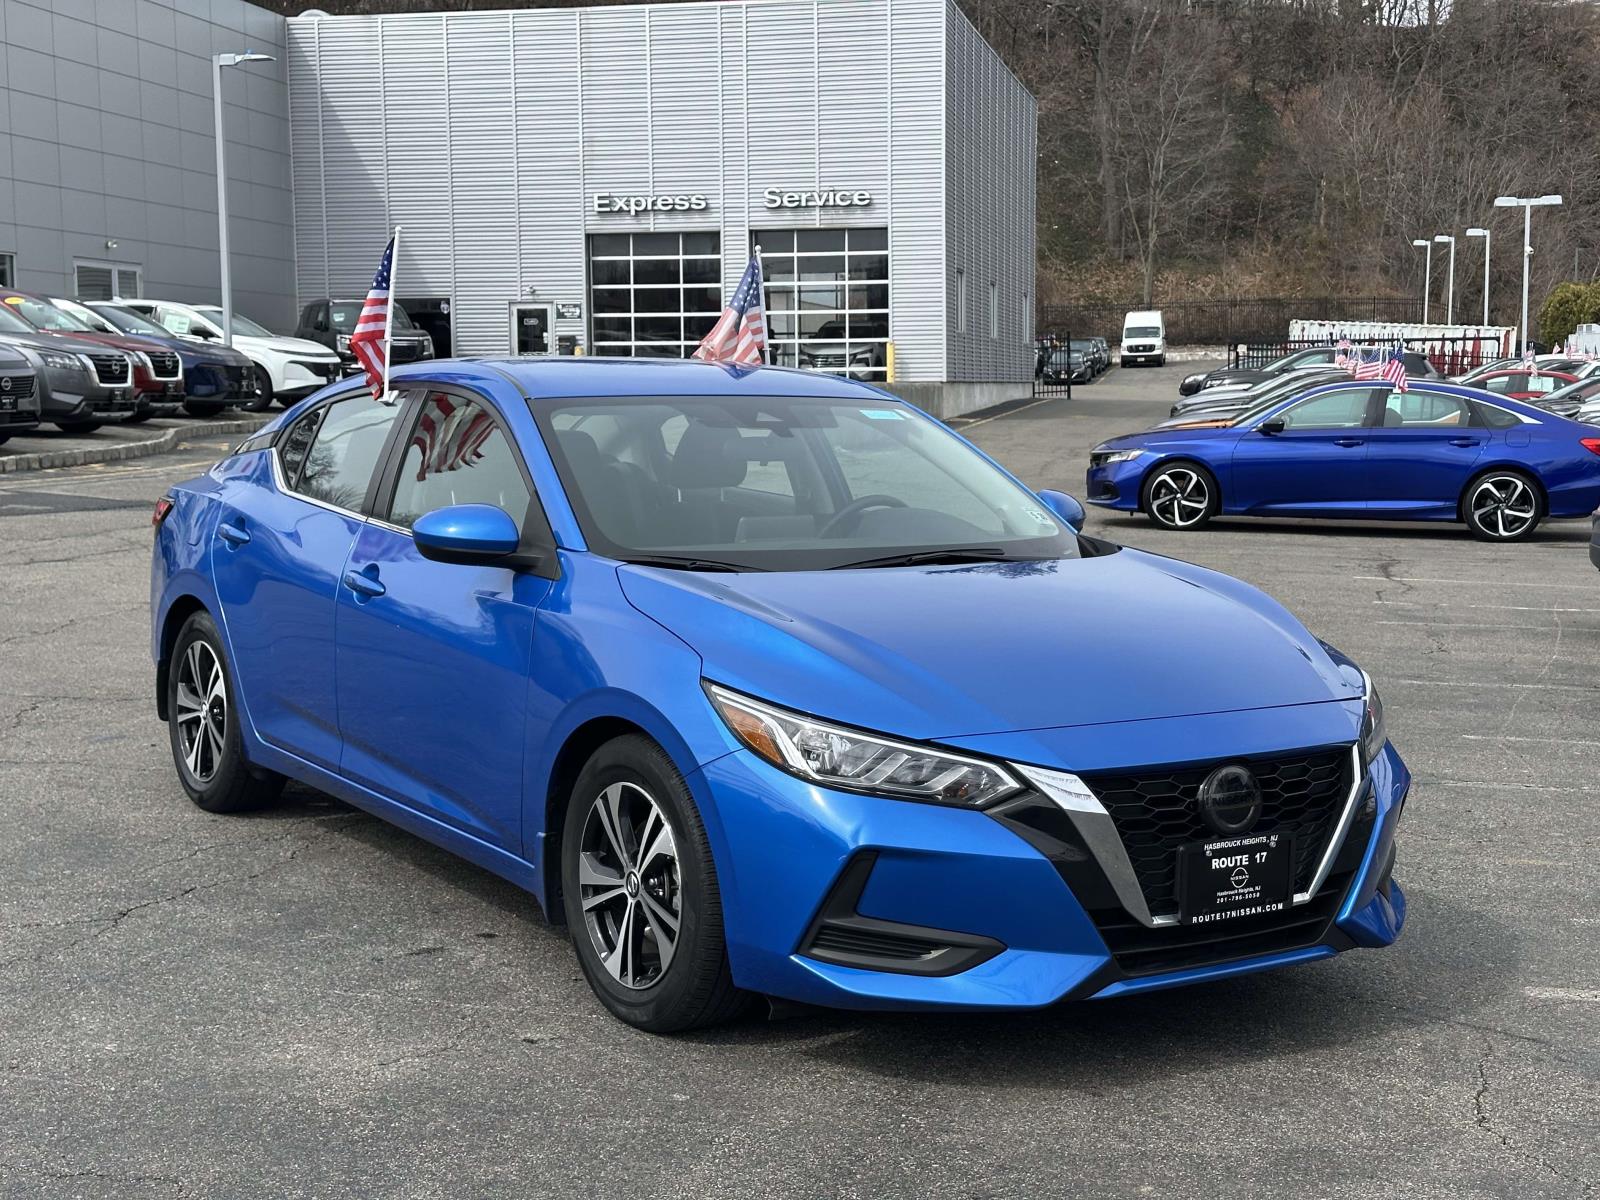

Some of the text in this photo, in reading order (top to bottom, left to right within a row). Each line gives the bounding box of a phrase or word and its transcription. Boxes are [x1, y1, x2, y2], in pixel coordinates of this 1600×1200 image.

[592, 191, 708, 216] Express
[763, 187, 872, 208] Service
[1204, 840, 1241, 850] HASBROUCK
[1212, 852, 1267, 869] ROUTE 17
[1192, 902, 1283, 924] ROUTE17NISSAN.COM
